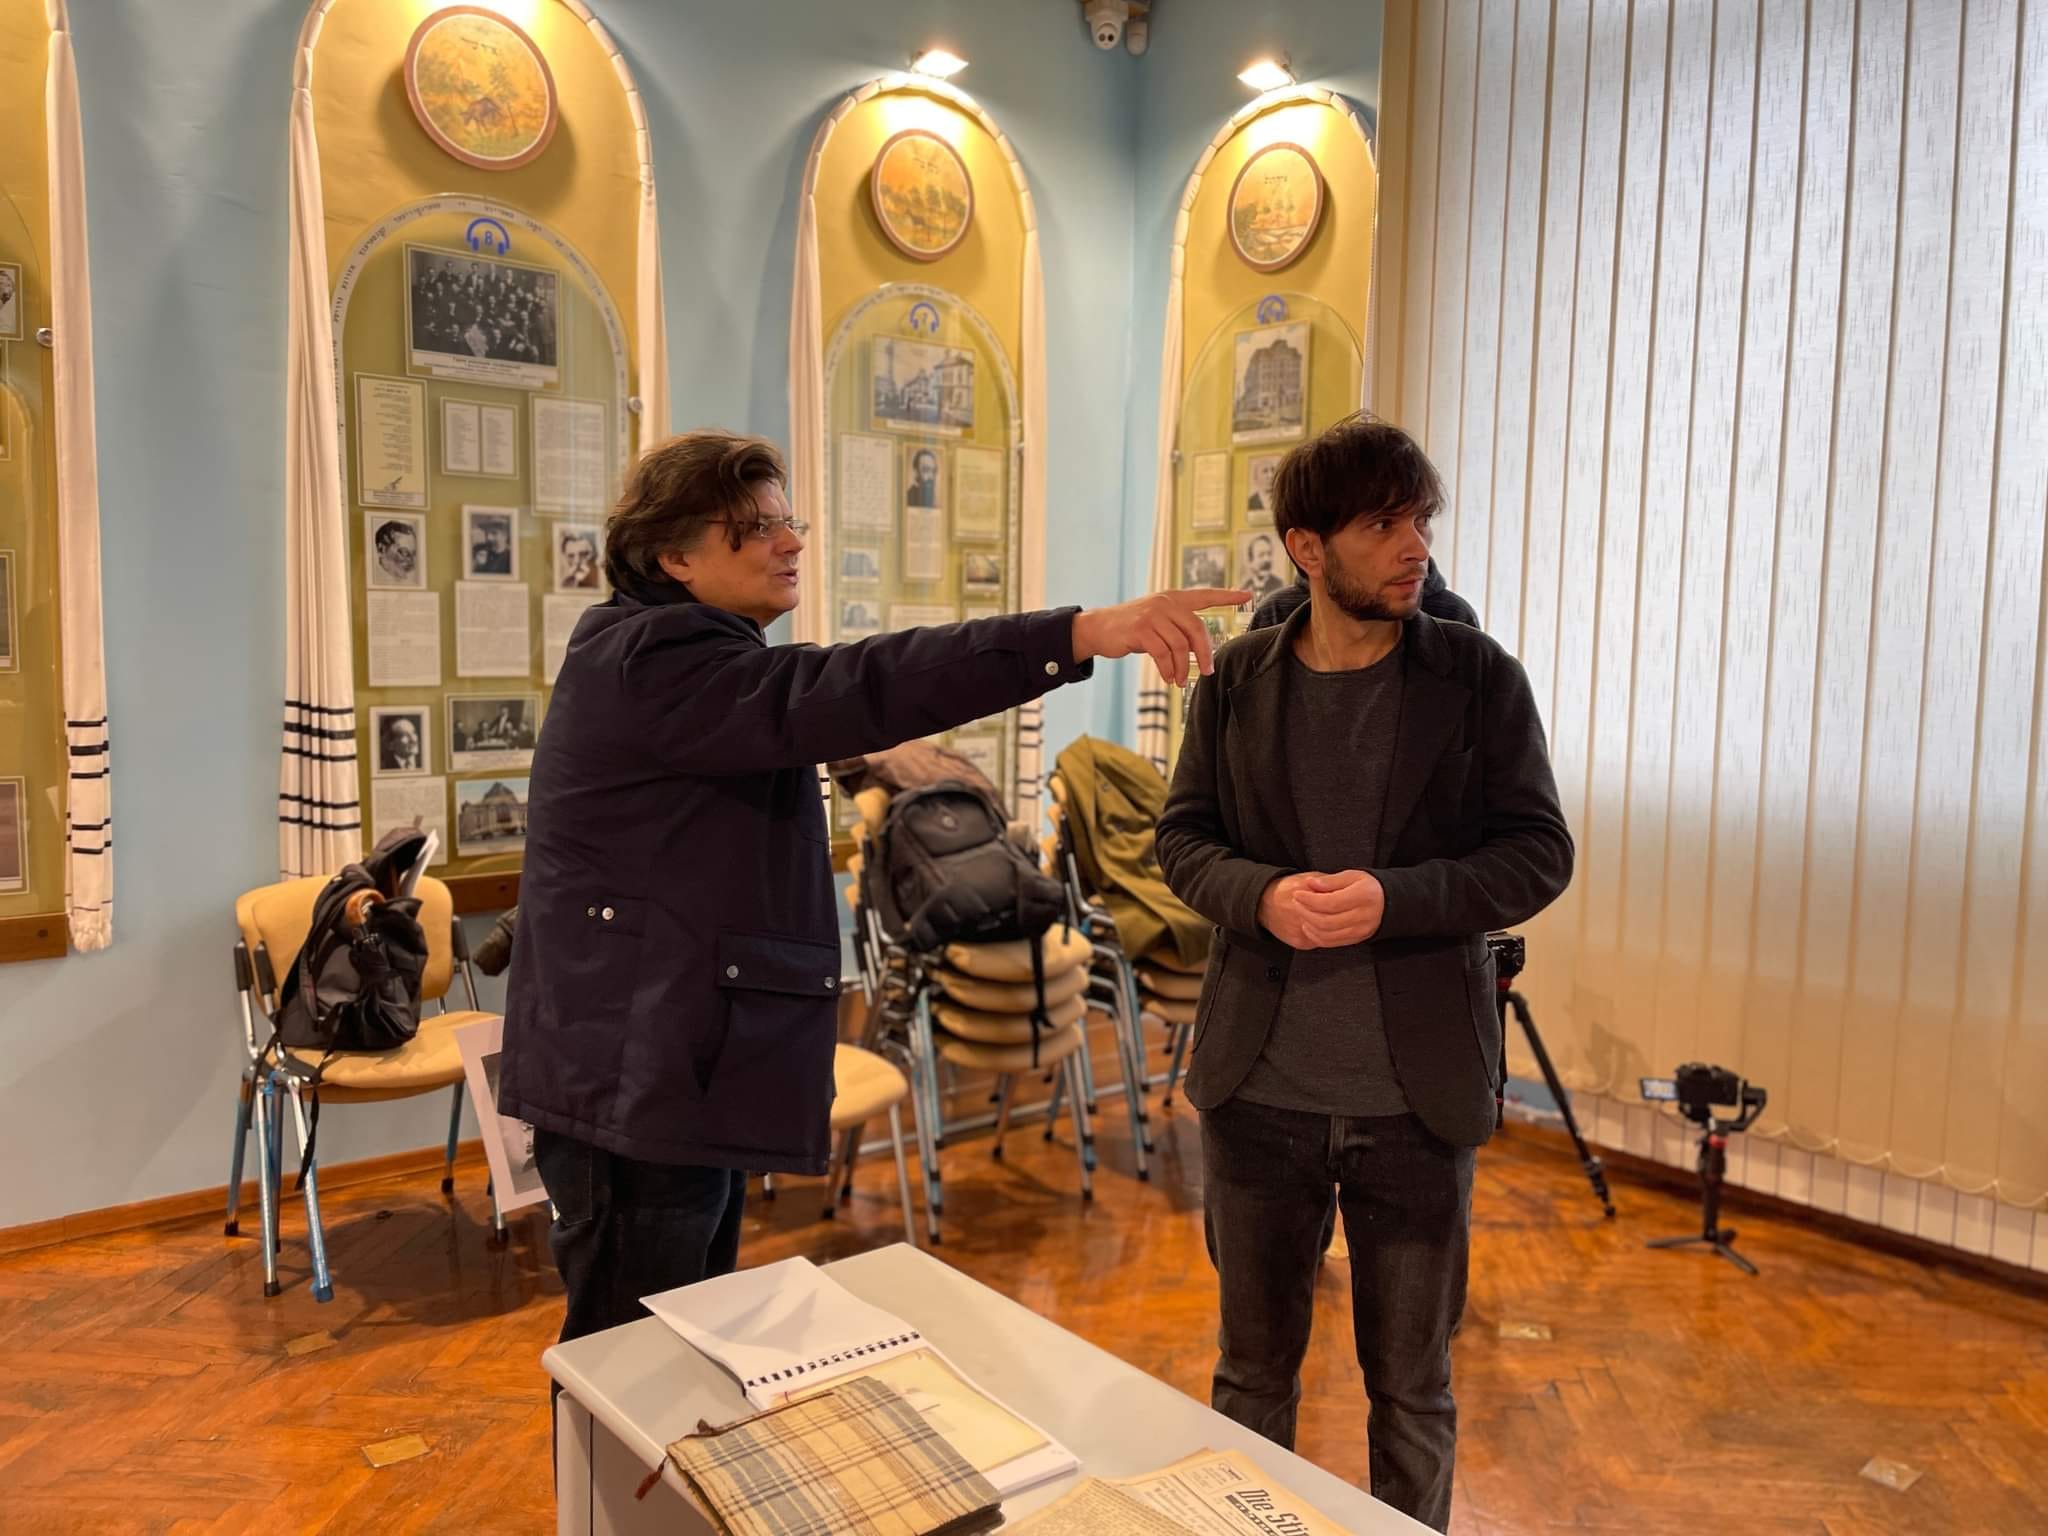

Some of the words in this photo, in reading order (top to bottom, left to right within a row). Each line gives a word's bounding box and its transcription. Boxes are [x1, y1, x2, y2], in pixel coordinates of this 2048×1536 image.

[484, 231, 493, 246] 8
[1235, 1489, 1274, 1511] Die
[1265, 1513, 1310, 1536] Sti
